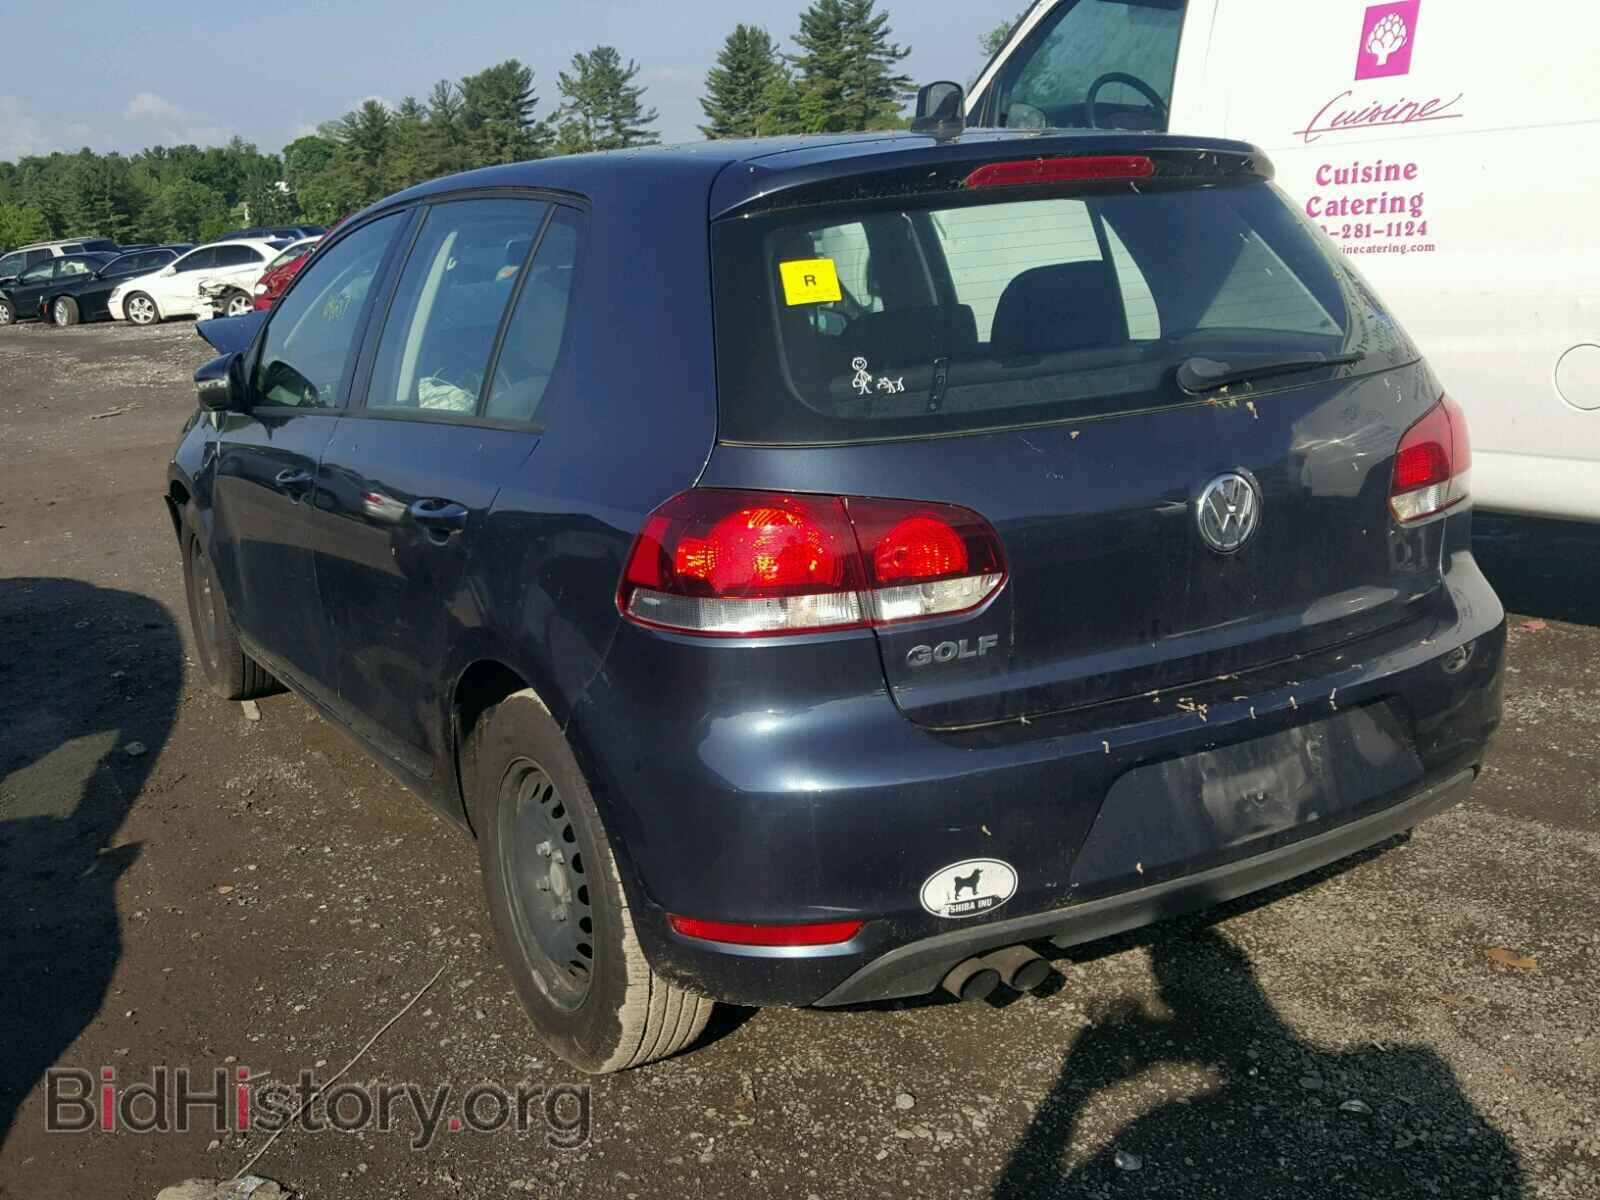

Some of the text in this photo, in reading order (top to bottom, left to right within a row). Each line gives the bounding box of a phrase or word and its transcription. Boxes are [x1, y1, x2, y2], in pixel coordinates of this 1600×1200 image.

[1304, 90, 1463, 143] Cuisine
[1315, 160, 1418, 186] Cuisine
[1305, 192, 1424, 218] Catering
[1339, 243, 1435, 255] inecatering.com
[804, 275, 816, 287] R
[906, 634, 999, 667] GOLF
[950, 898, 993, 913] SHIBA INU
